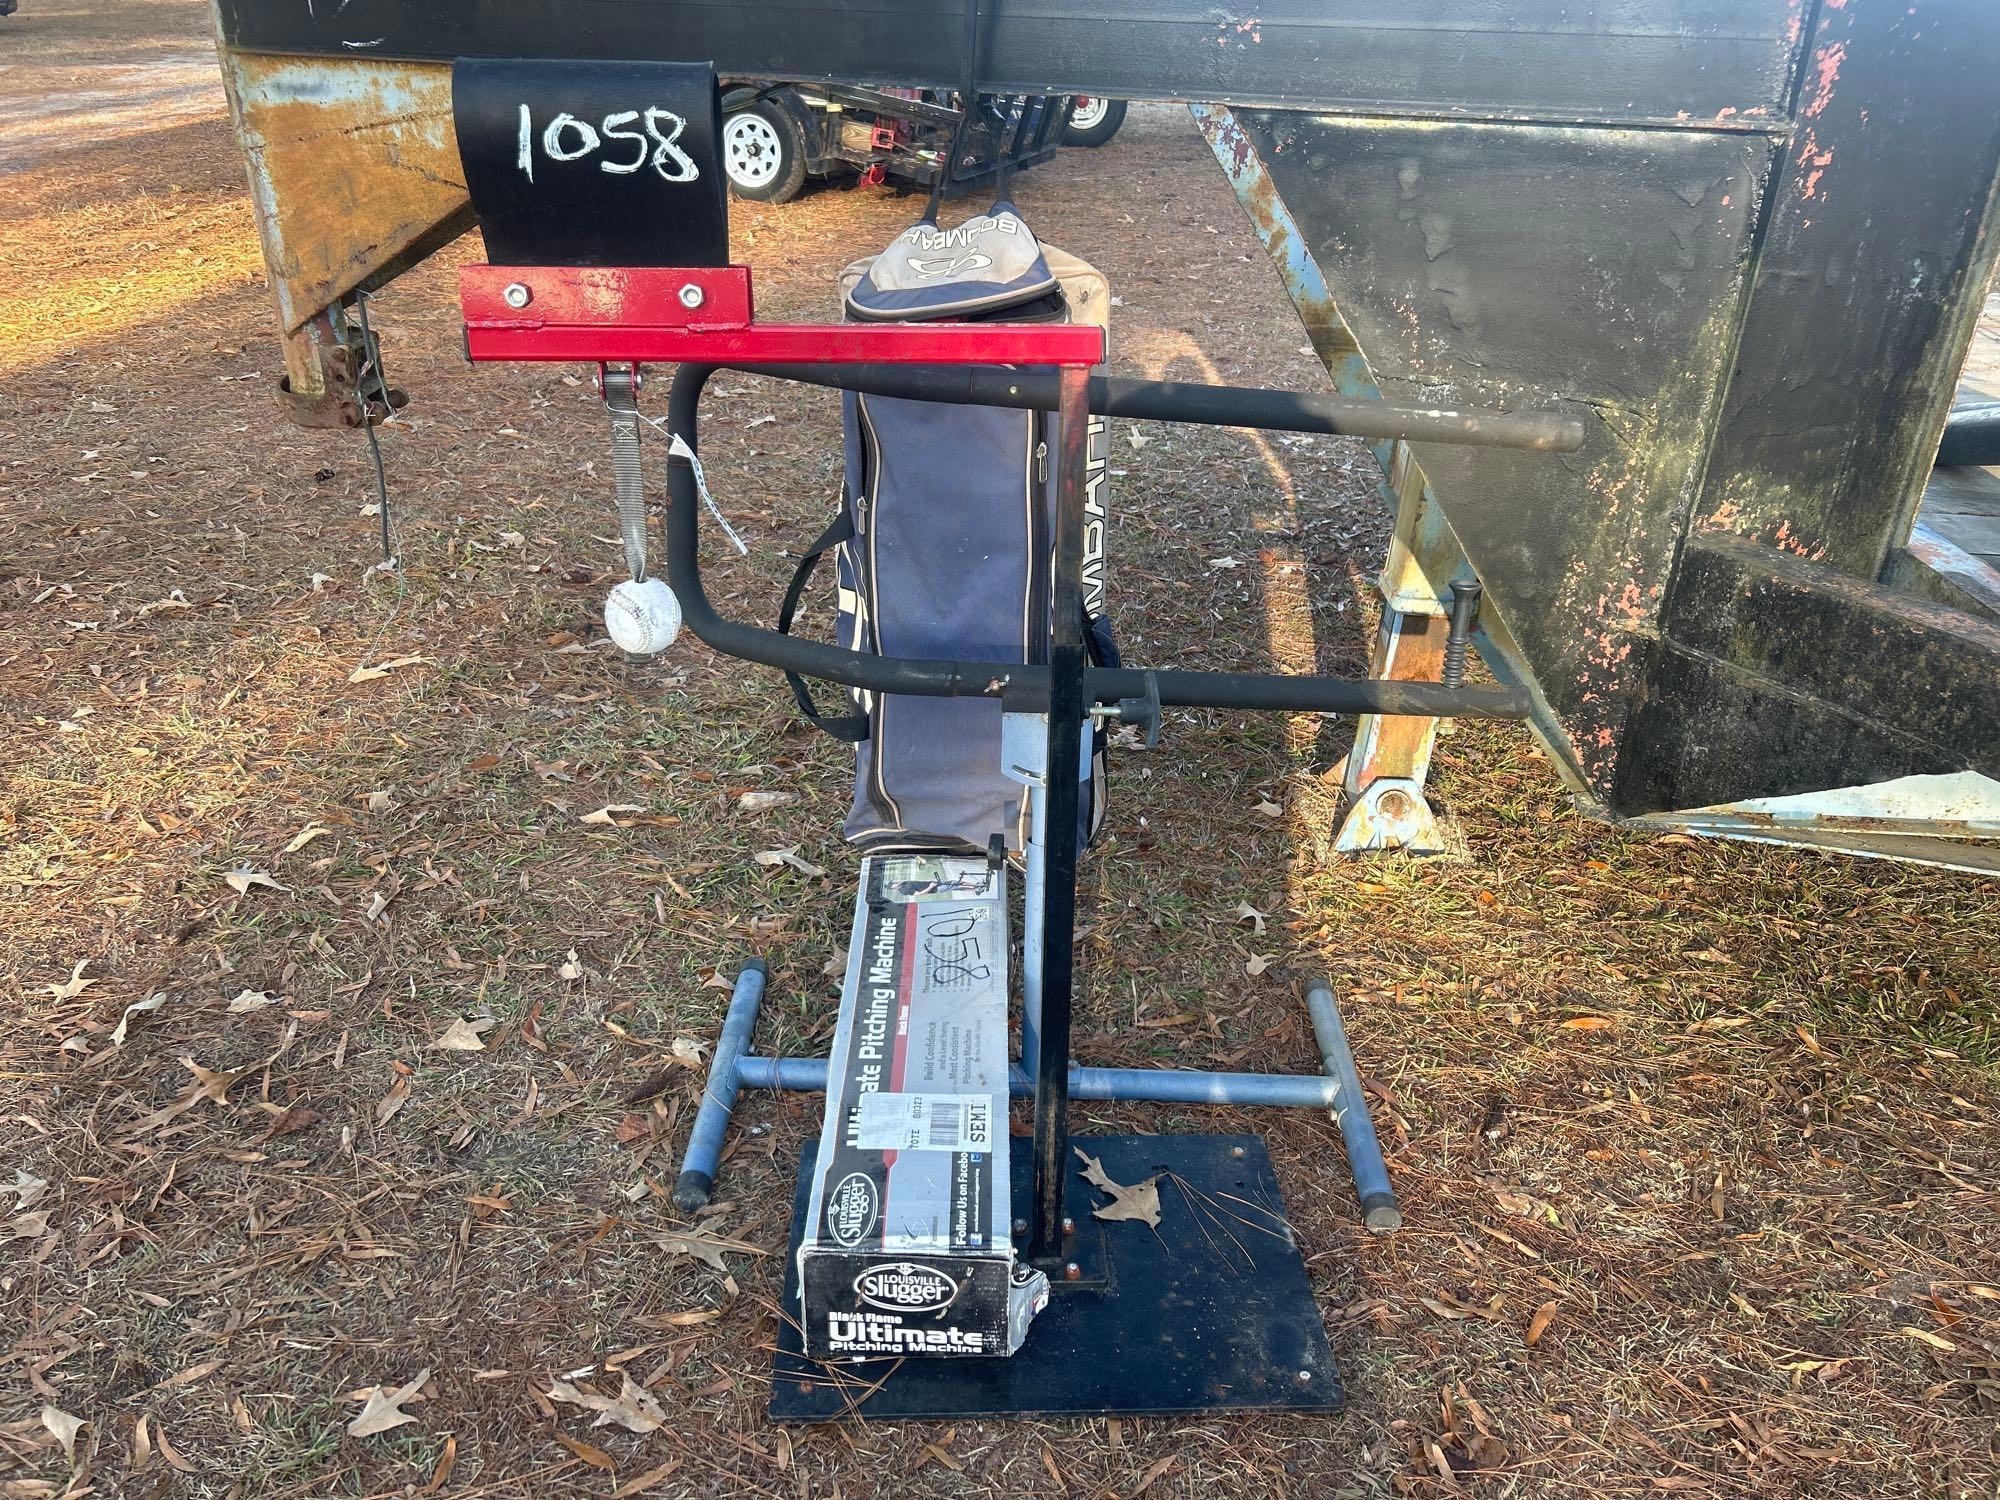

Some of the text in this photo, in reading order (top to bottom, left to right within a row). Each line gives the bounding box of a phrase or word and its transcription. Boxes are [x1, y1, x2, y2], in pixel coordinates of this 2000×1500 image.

[517, 103, 700, 184] 1058
[898, 218, 1019, 251] BOOMBAH
[868, 917, 898, 983] Machine
[920, 908, 990, 985] 1058
[858, 988, 896, 1060] Pitching
[923, 1021, 936, 1081] Build Confidence
[949, 1026, 959, 1061] Consistent
[962, 1029, 973, 1084] Pitching Machine
[949, 1062, 957, 1080] Most
[910, 1129, 919, 1149] TOTE
[970, 1103, 986, 1143] SEMI
[958, 1152, 968, 1183] Facebo
[840, 1184, 852, 1224] LOUISVILLE
[957, 1197, 967, 1209] Us
[960, 1184, 967, 1196] on
[839, 1180, 869, 1238] Slugger
[956, 1210, 967, 1245] Follow
[864, 1276, 944, 1304] Slugger
[883, 1275, 941, 1286] LOUISVILLE
[829, 1312, 902, 1324] Black Flame
[830, 1321, 983, 1346] Ultimate
[830, 1342, 982, 1353] Pitching Machine
